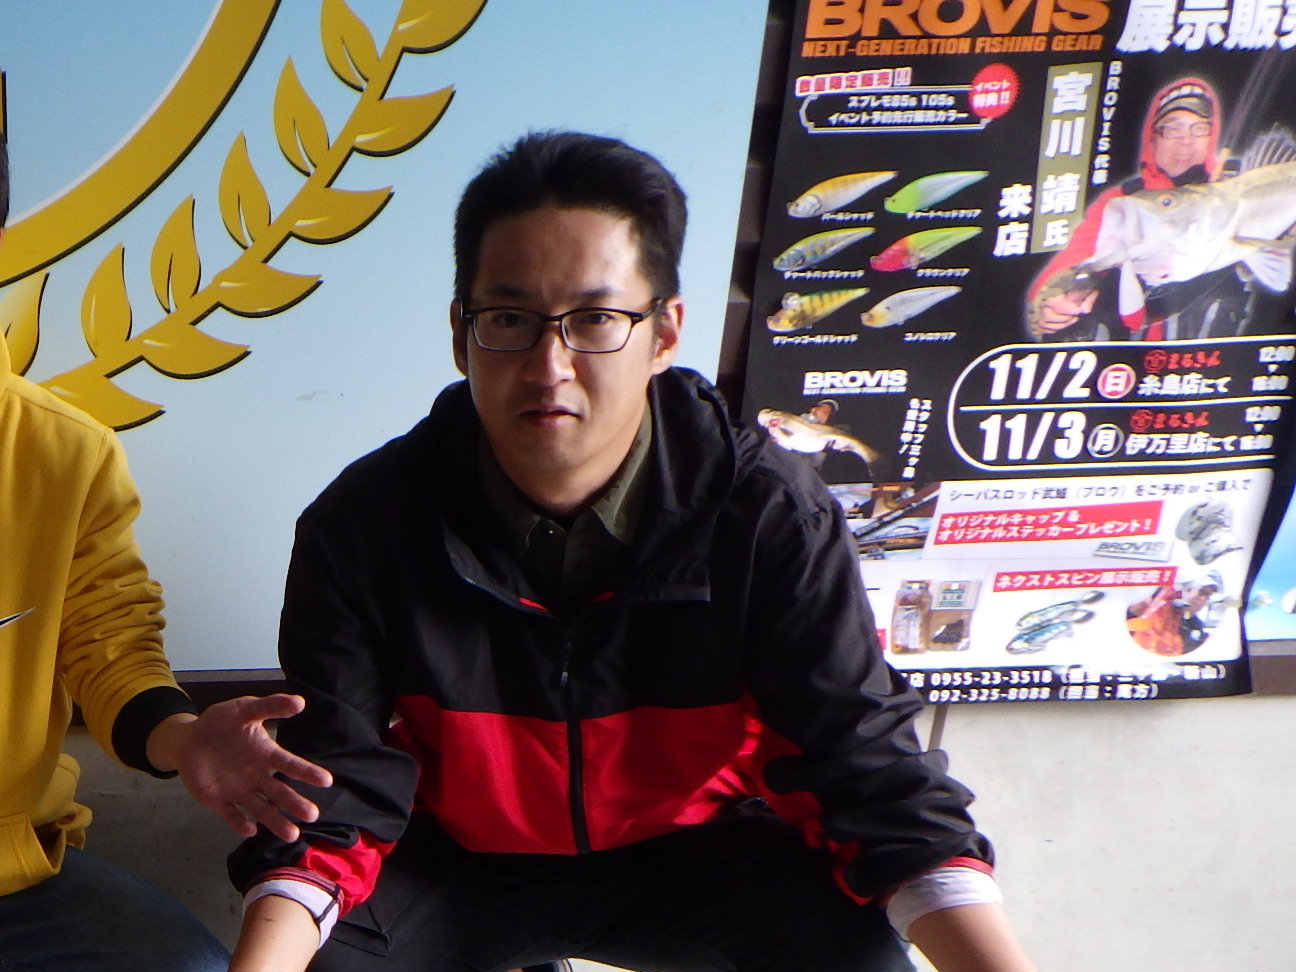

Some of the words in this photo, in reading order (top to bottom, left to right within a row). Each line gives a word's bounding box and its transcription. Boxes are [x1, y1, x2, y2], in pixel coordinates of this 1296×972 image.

[804, 0, 1111, 38] BROVIS
[801, 38, 971, 58] NEXT-GENERATION
[975, 36, 1048, 54] FISHING
[1051, 34, 1103, 51] GEAR
[993, 184, 1033, 257] 来店
[804, 369, 908, 388] BROVIS
[988, 350, 1098, 401] 11/2
[979, 411, 1087, 461] 11/3
[930, 669, 1053, 687] 0955-23-3518
